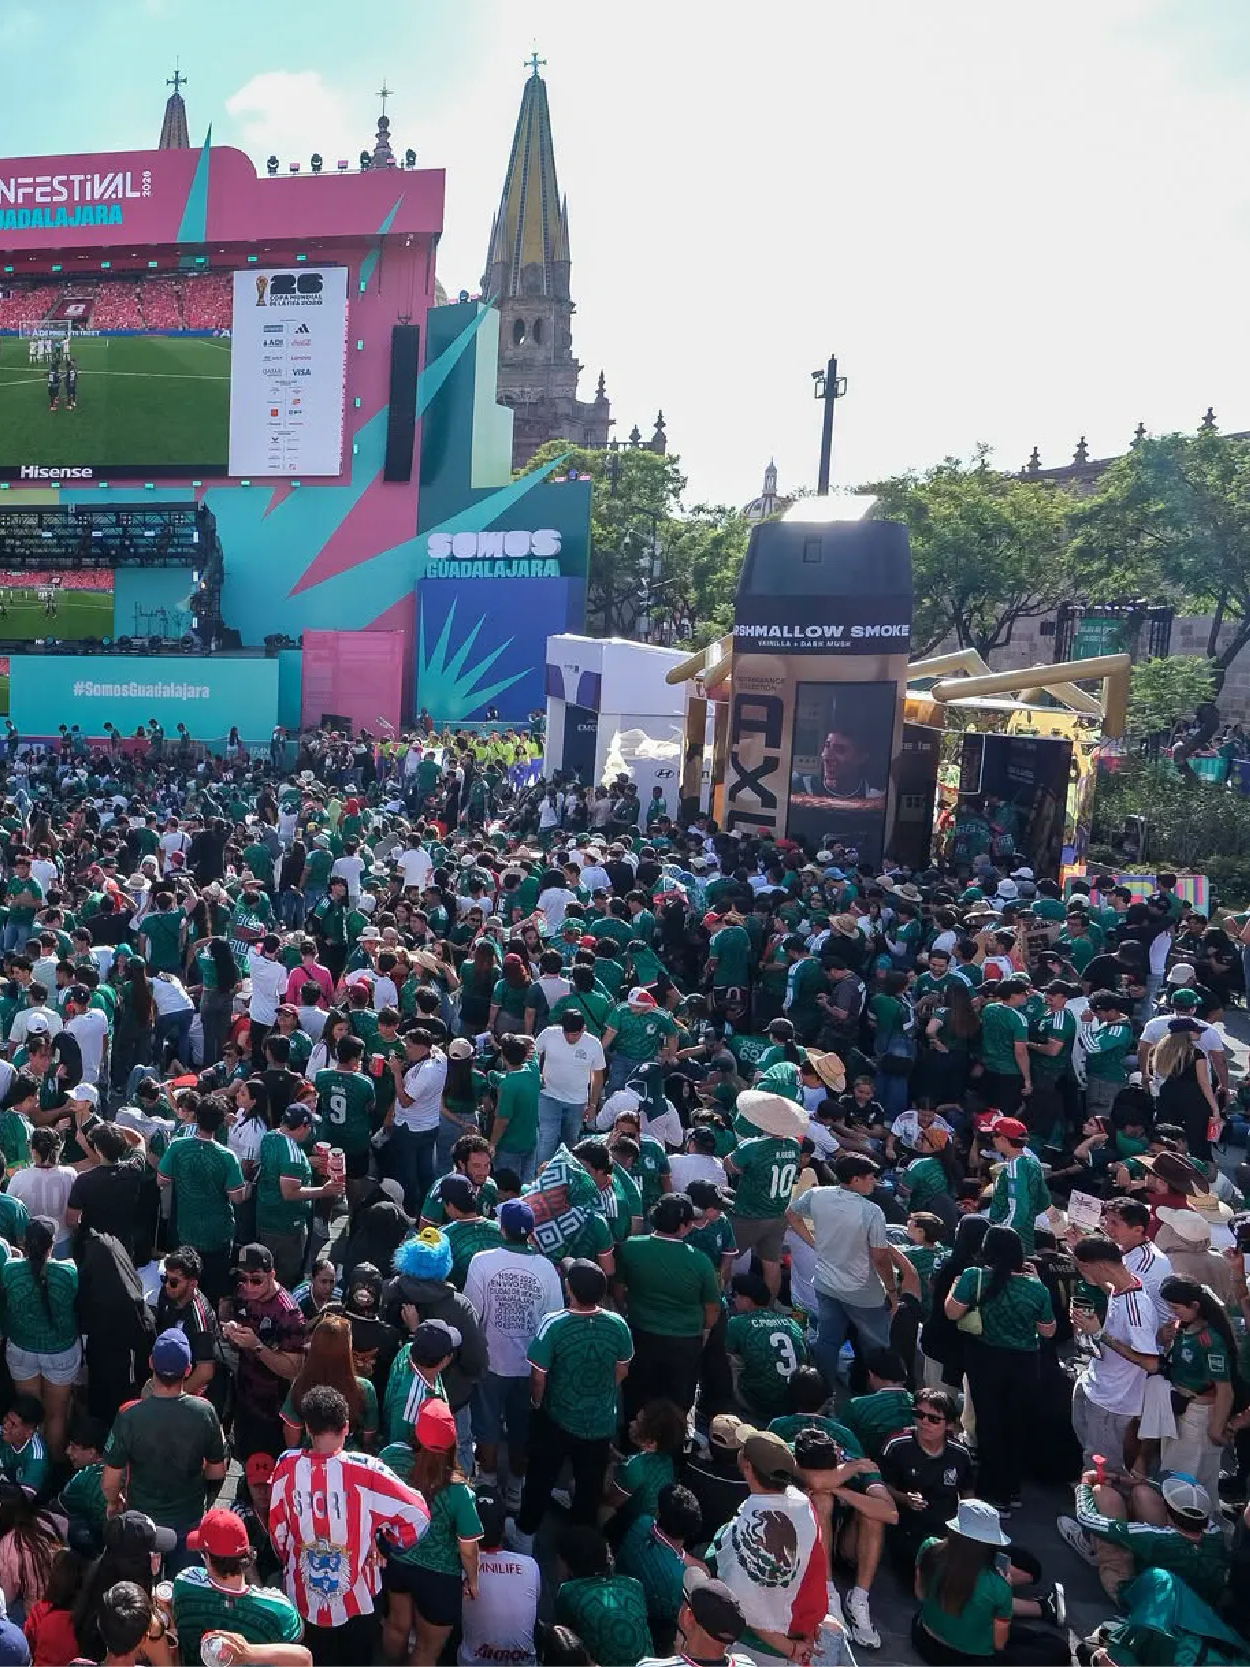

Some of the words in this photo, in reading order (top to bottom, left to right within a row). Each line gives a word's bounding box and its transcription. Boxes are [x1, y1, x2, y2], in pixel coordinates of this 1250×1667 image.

[142, 170, 152, 198] 2026
[20, 465, 93, 478] Hisense
[427, 528, 563, 558] SOMOS
[426, 558, 561, 578] GUADALAJARA
[850, 624, 911, 637] SMOKE
[73, 681, 210, 701] #SomosGuadalajara
[330, 1095, 347, 1124] 9
[770, 1164, 796, 1199] 10
[770, 1332, 797, 1376] 3
